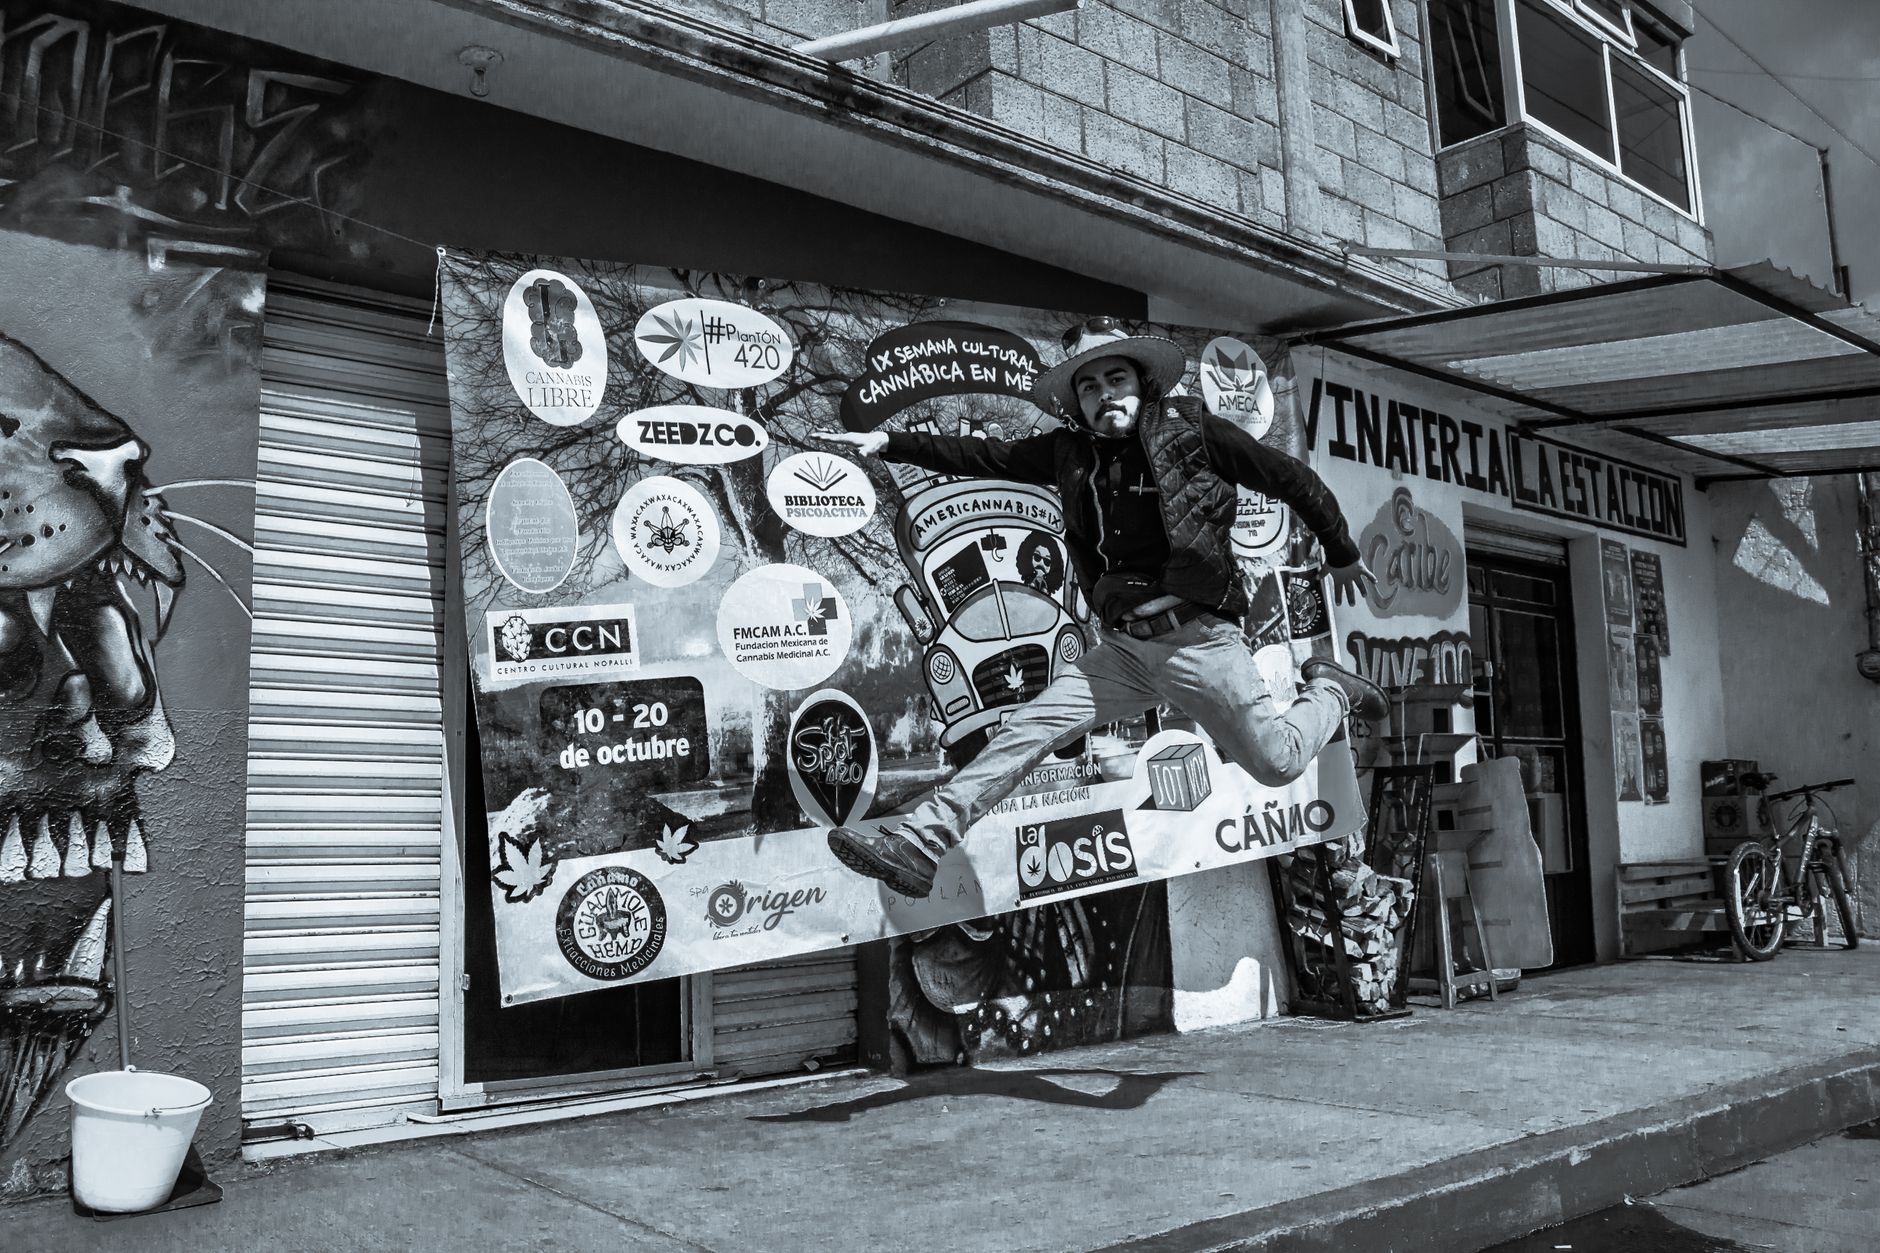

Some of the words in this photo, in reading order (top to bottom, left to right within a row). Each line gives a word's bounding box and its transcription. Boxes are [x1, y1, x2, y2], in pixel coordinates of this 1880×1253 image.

[734, 343, 780, 370] 420
[871, 351, 893, 373] IX
[894, 338, 957, 365] SEMANA
[962, 341, 1039, 374] CULTURAL
[525, 371, 592, 388] CANNABIS
[859, 361, 964, 404] CANNÁBICA
[970, 364, 996, 382] EN
[528, 387, 594, 409] LIBRE
[1218, 394, 1262, 415] AMECA
[1301, 378, 1509, 498] VINATERIA
[784, 495, 866, 507] BIBLIOTECA
[786, 507, 868, 518] PSICOACTIVA
[545, 624, 621, 653] CCN
[733, 625, 781, 639] FMCAM
[784, 624, 807, 636] A.C.
[735, 640, 779, 651] Fundacion
[781, 638, 817, 648] Mexicana
[819, 637, 829, 646] de
[736, 652, 775, 662] Cannabis
[777, 649, 813, 660] Medicinal
[815, 648, 831, 657] A.C.
[497, 665, 536, 675] CENTRO
[541, 662, 589, 672] CULTURAL
[594, 658, 633, 668] NOPALLI
[573, 709, 604, 735] 10
[633, 702, 668, 728] 20
[560, 744, 589, 769] de
[599, 733, 690, 765] octubre
[1152, 764, 1185, 808] JOT
[1185, 751, 1210, 801] VOX
[1022, 795, 1038, 810] LA
[1042, 787, 1090, 807] NACIÓN!
[1019, 826, 1037, 846] la
[1019, 824, 1133, 887] dosis
[705, 880, 827, 931] Origen
[560, 926, 616, 977] Extracciones
[619, 917, 665, 976] Medicinales
[588, 938, 643, 958] HEMP
